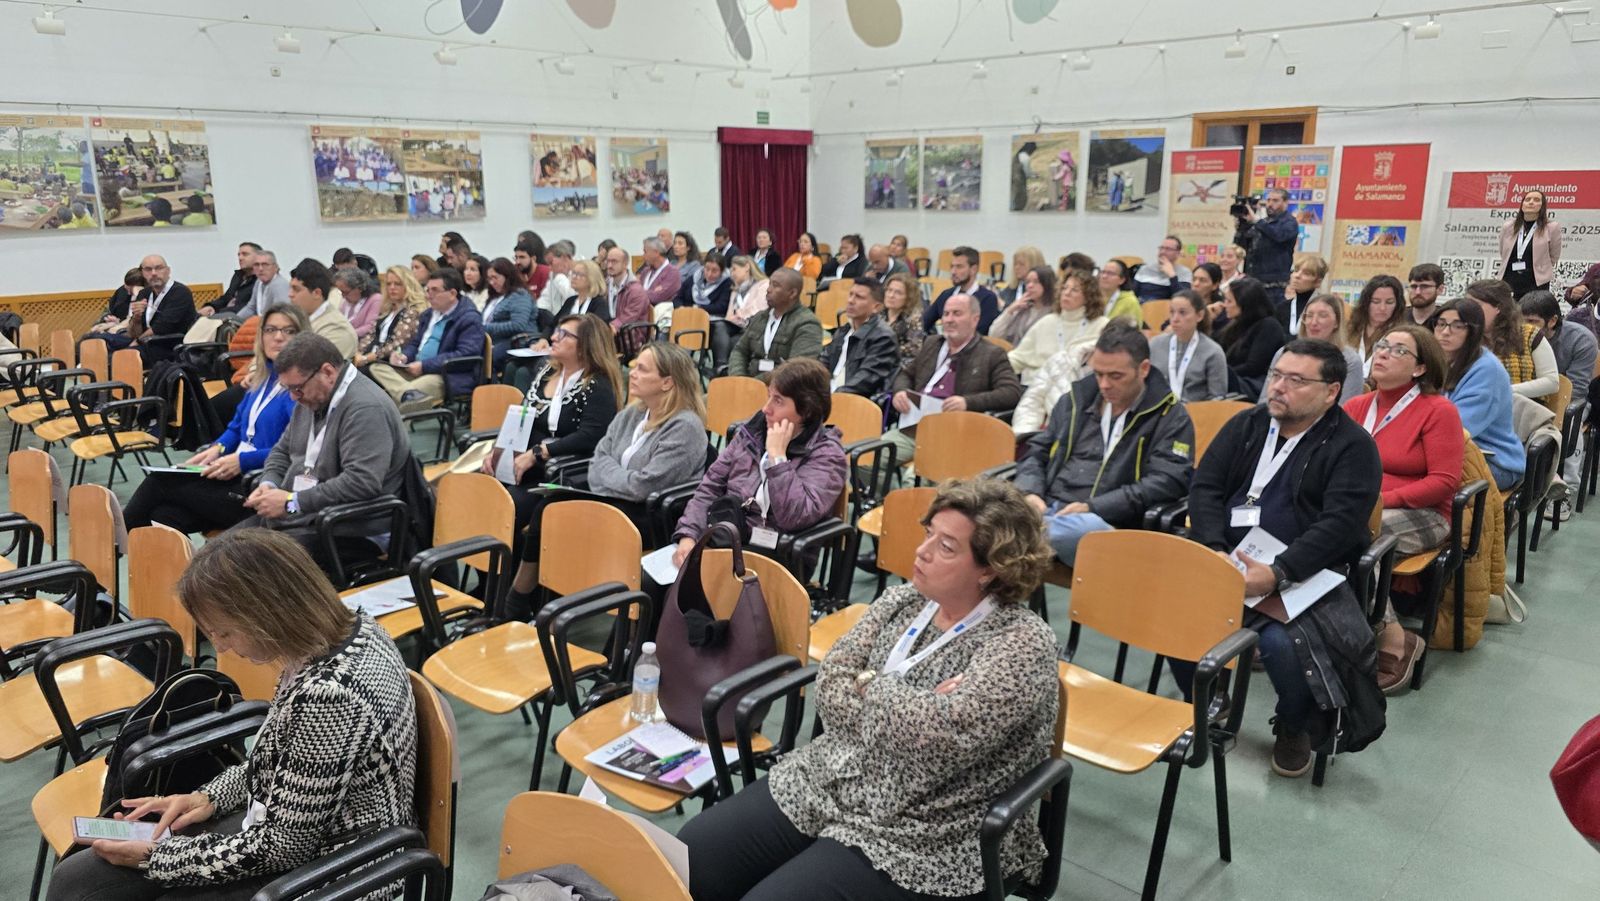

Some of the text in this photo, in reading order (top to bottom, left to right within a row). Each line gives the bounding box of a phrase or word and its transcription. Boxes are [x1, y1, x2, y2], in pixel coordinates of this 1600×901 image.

[1355, 183, 1407, 192] Ayuntamiento
[1512, 184, 1578, 193] Ayuntamiento
[1511, 194, 1521, 203] de
[1444, 223, 1501, 233] Salamanc
[1571, 225, 1600, 235] 2025
